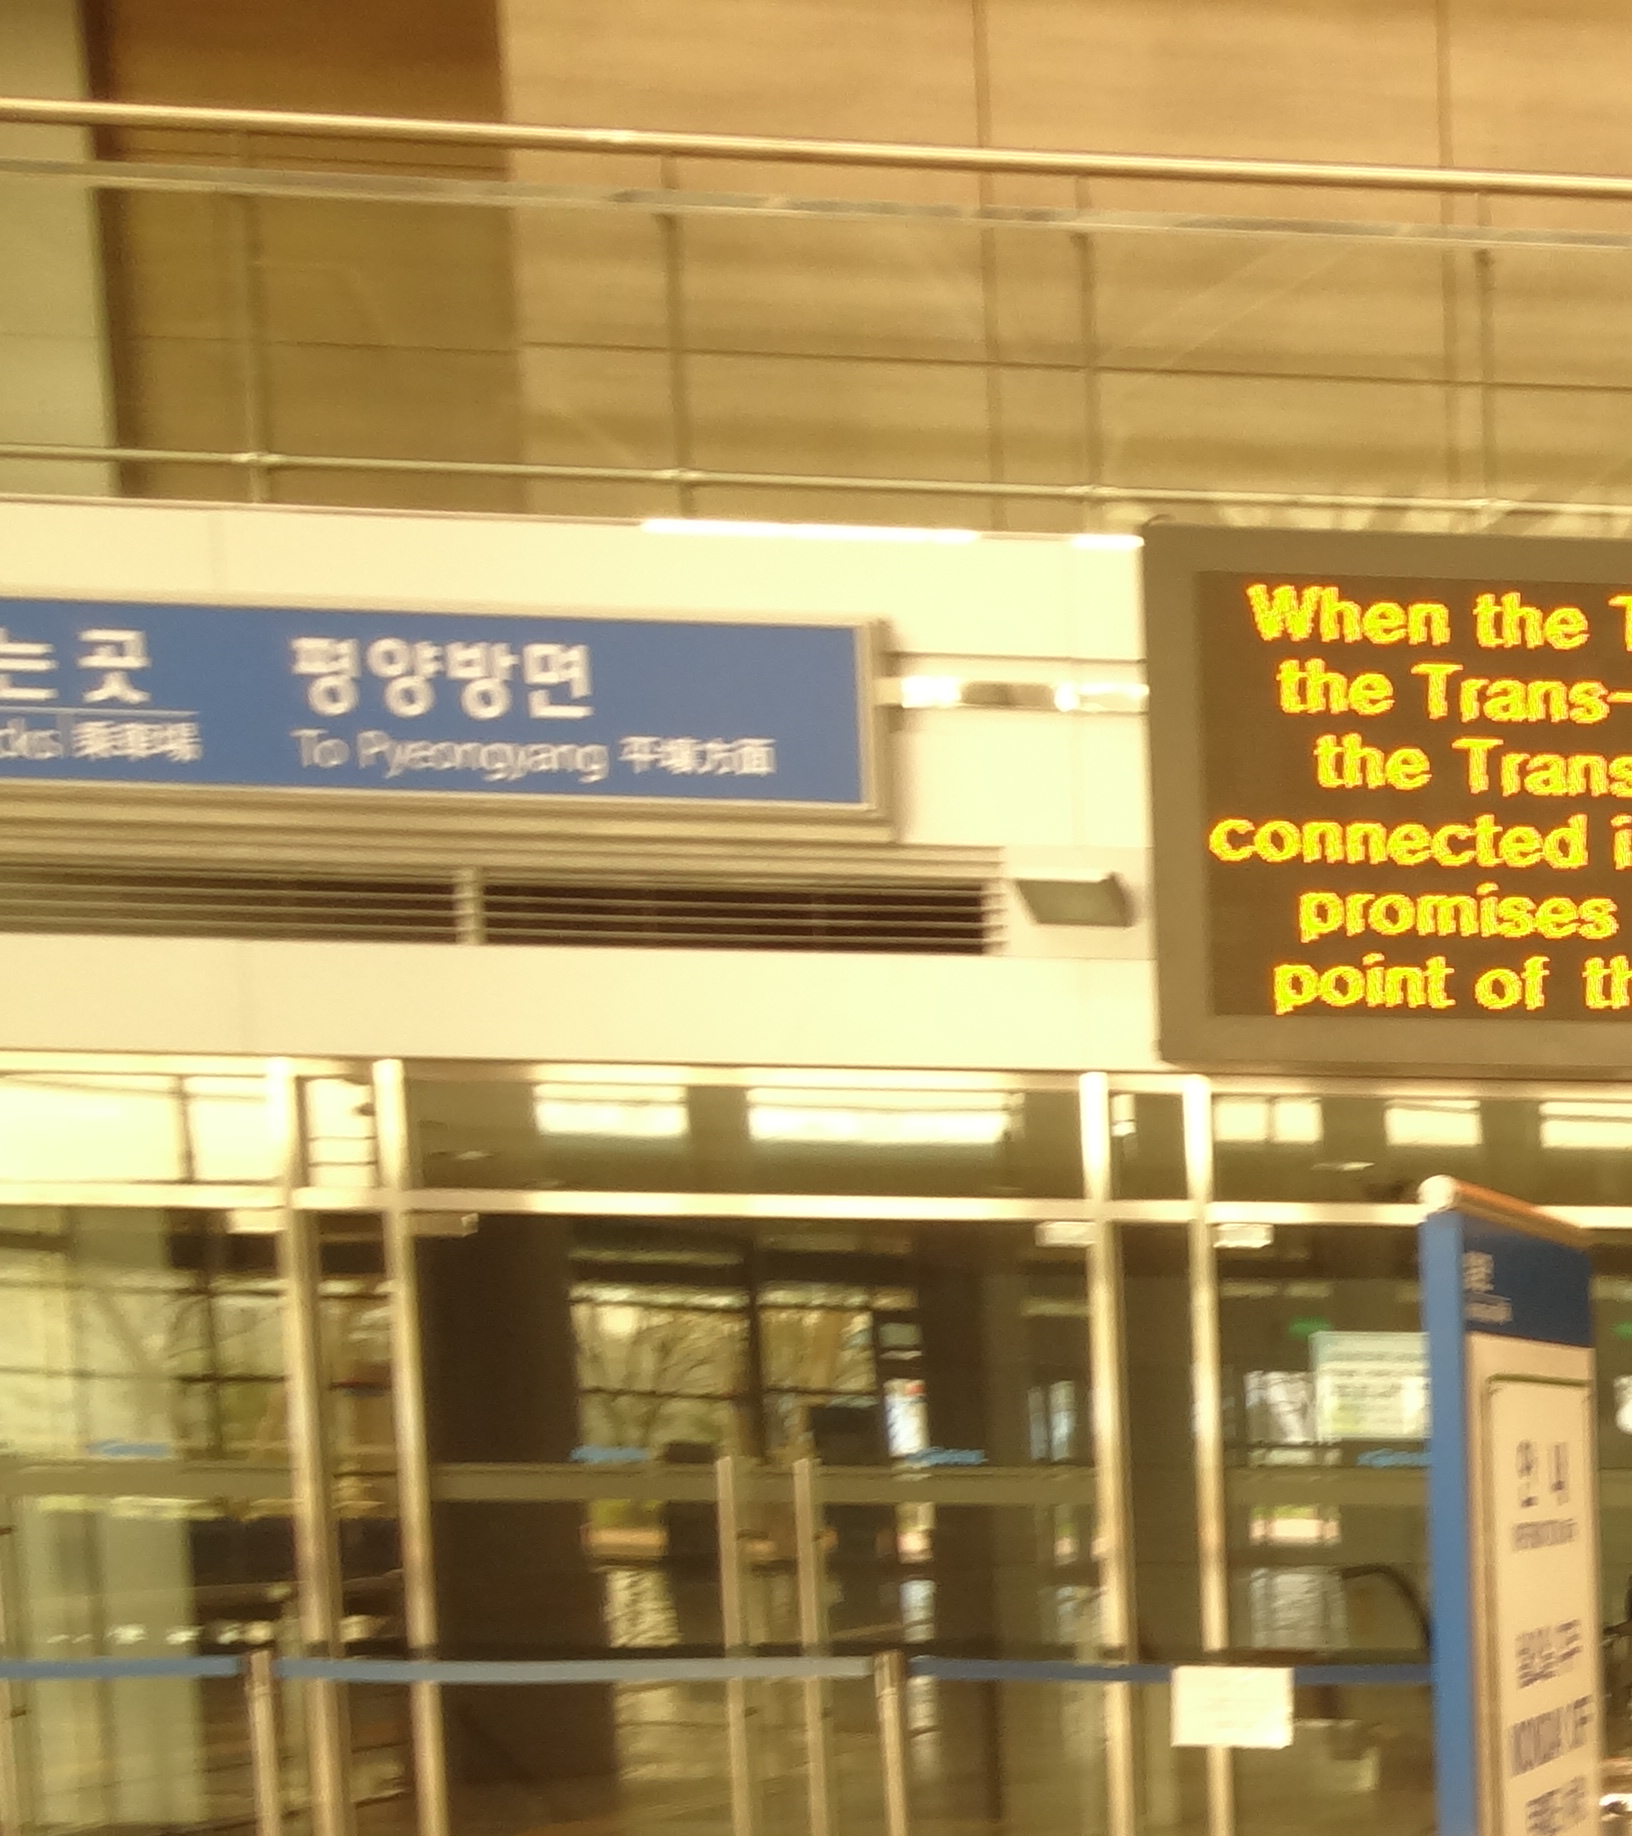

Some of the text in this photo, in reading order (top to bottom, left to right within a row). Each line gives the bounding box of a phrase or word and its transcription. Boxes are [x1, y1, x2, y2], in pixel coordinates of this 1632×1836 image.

[1245, 582, 1452, 647] When
[1471, 590, 1591, 652] the
[77, 628, 153, 705] 곳
[290, 636, 595, 721] 평양방면
[1274, 656, 1397, 717] the
[290, 728, 351, 769] To
[356, 730, 611, 784] Pyeongyang
[1312, 731, 1434, 792] the
[1207, 812, 1590, 871] connected
[1297, 880, 1621, 945] promises
[1272, 951, 1457, 1017] point
[1473, 954, 1551, 1012] of
